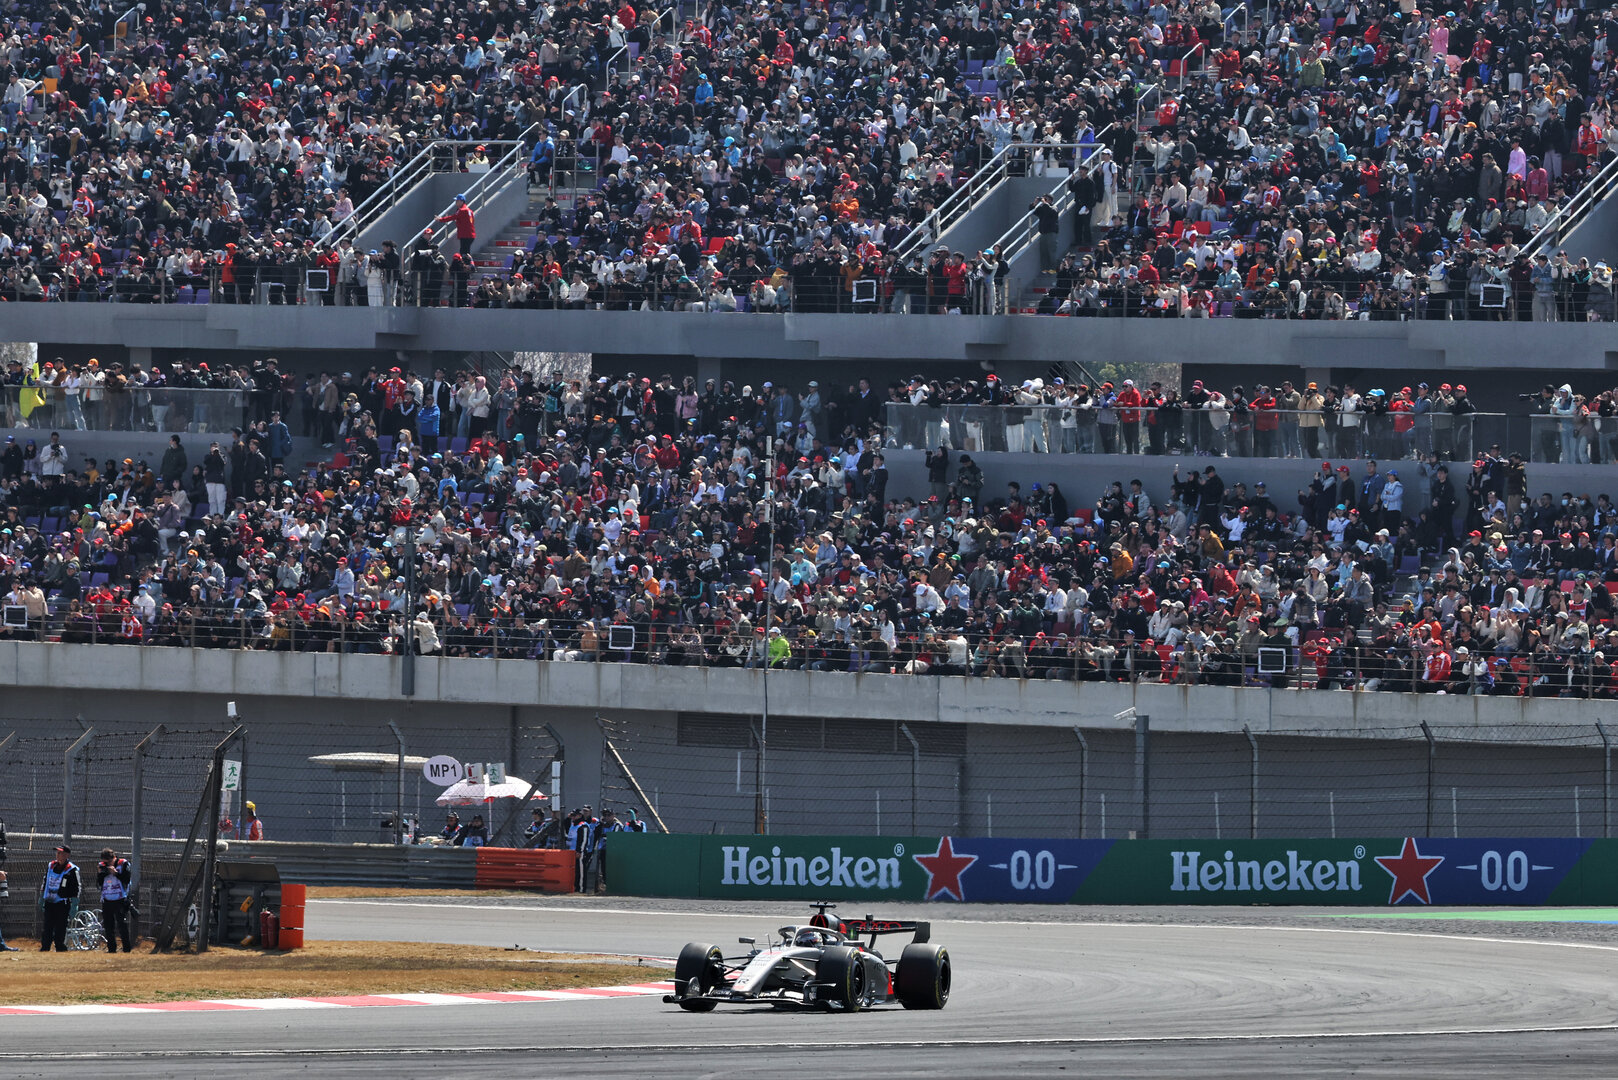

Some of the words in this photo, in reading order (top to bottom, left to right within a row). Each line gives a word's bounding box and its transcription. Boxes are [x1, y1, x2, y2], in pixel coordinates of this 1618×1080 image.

[429, 764, 457, 778] MP1
[721, 846, 902, 889] Heineken
[1010, 850, 1055, 890] 0.0
[1170, 850, 1363, 891] Heineken
[1481, 850, 1529, 892] 0.0
[189, 908, 197, 932] 2
